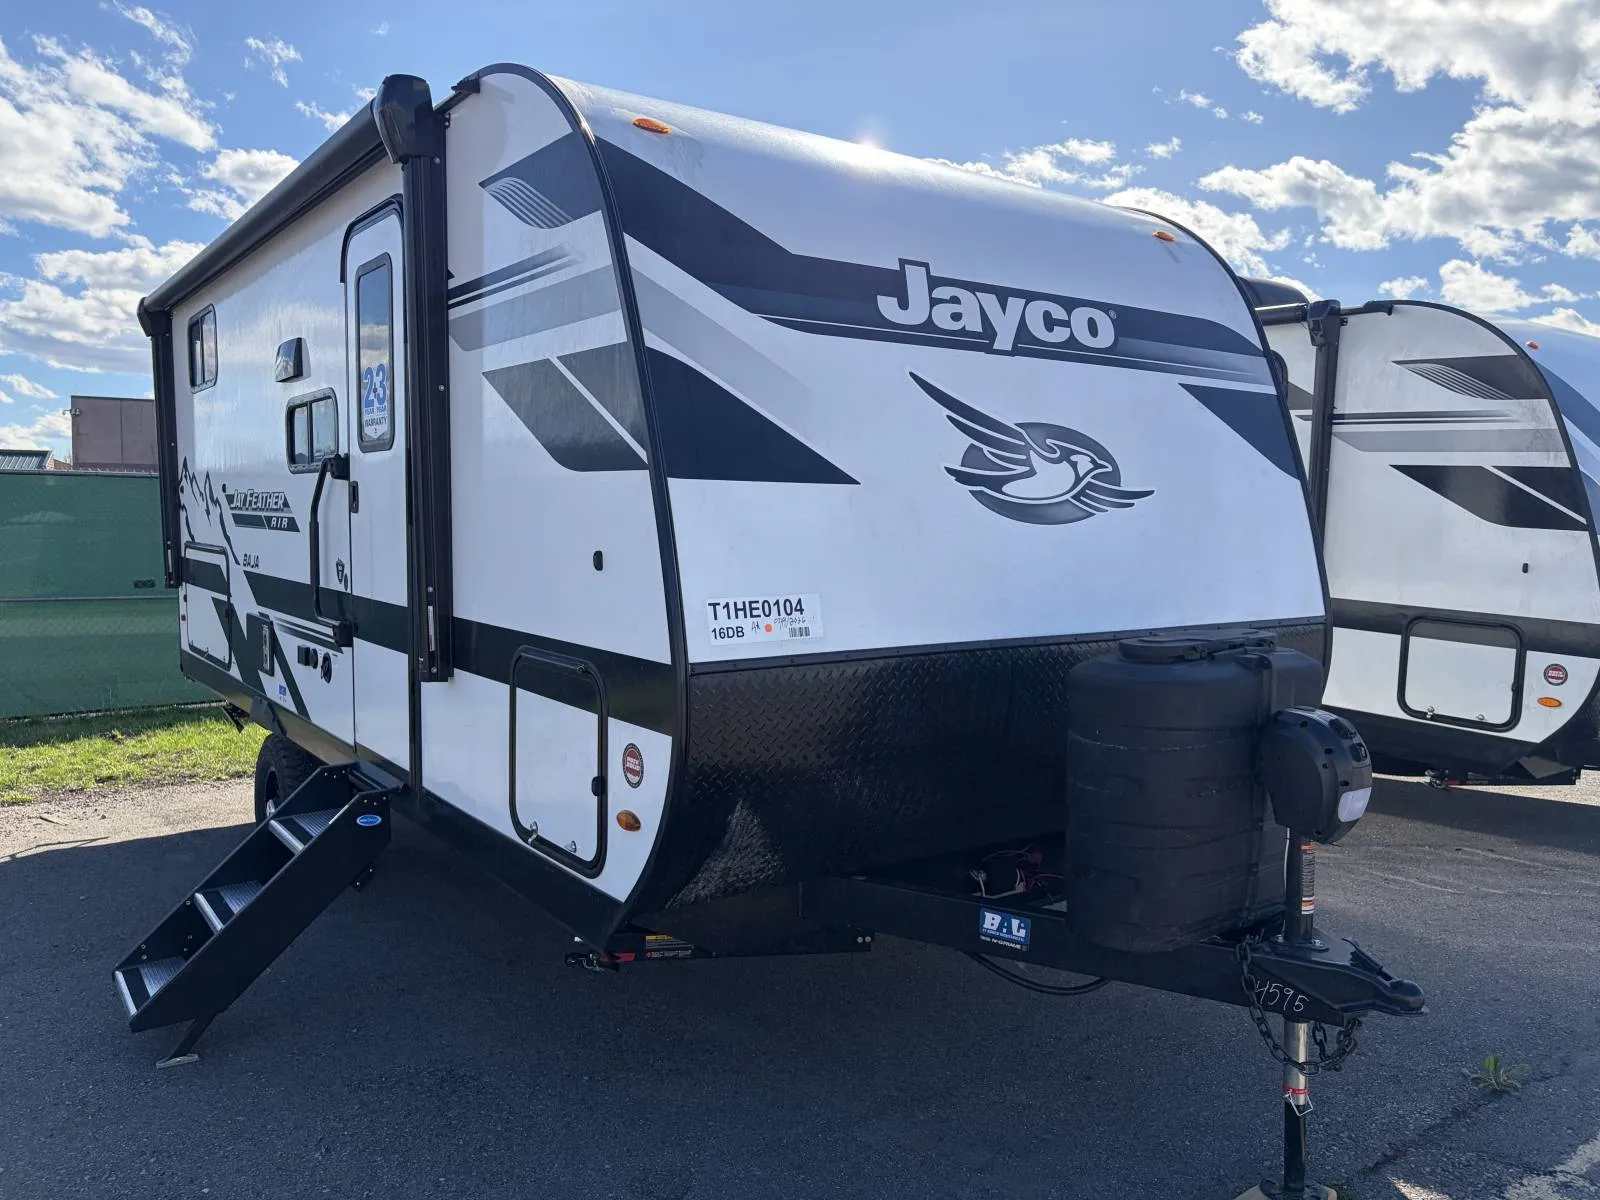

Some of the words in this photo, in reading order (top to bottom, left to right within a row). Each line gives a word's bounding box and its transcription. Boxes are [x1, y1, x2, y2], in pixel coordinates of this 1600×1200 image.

[876, 263, 1116, 351] Jayco
[365, 416, 387, 427] WARRANTY
[231, 488, 246, 508] JAY
[246, 488, 286, 510] FEATHER
[270, 516, 288, 529] AIR
[243, 553, 260, 569] BAJA
[707, 597, 805, 622] T1HE0104
[711, 625, 745, 640] 16DB
[983, 911, 1027, 938] BAL
